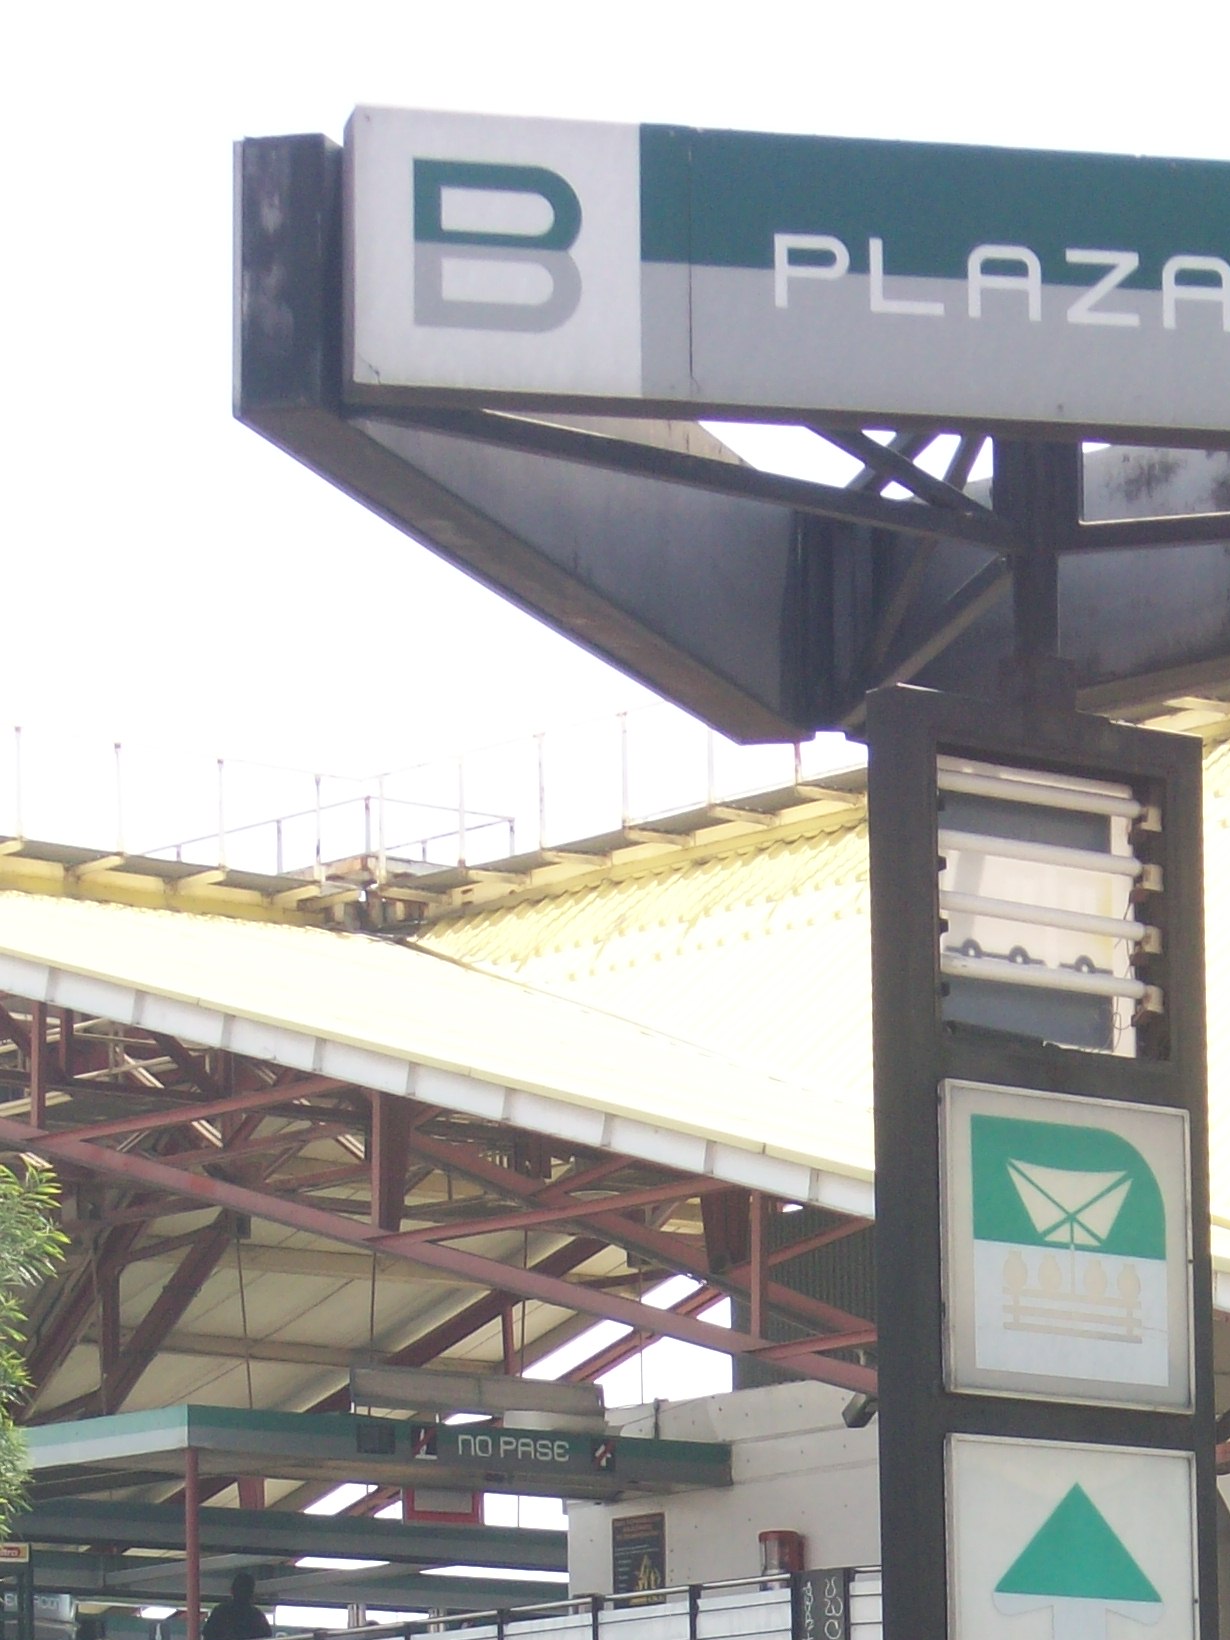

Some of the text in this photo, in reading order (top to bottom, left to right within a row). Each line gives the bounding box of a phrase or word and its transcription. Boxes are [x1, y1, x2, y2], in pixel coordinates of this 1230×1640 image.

[412, 158, 583, 333] B
[457, 1433, 570, 1462] NO PASE
